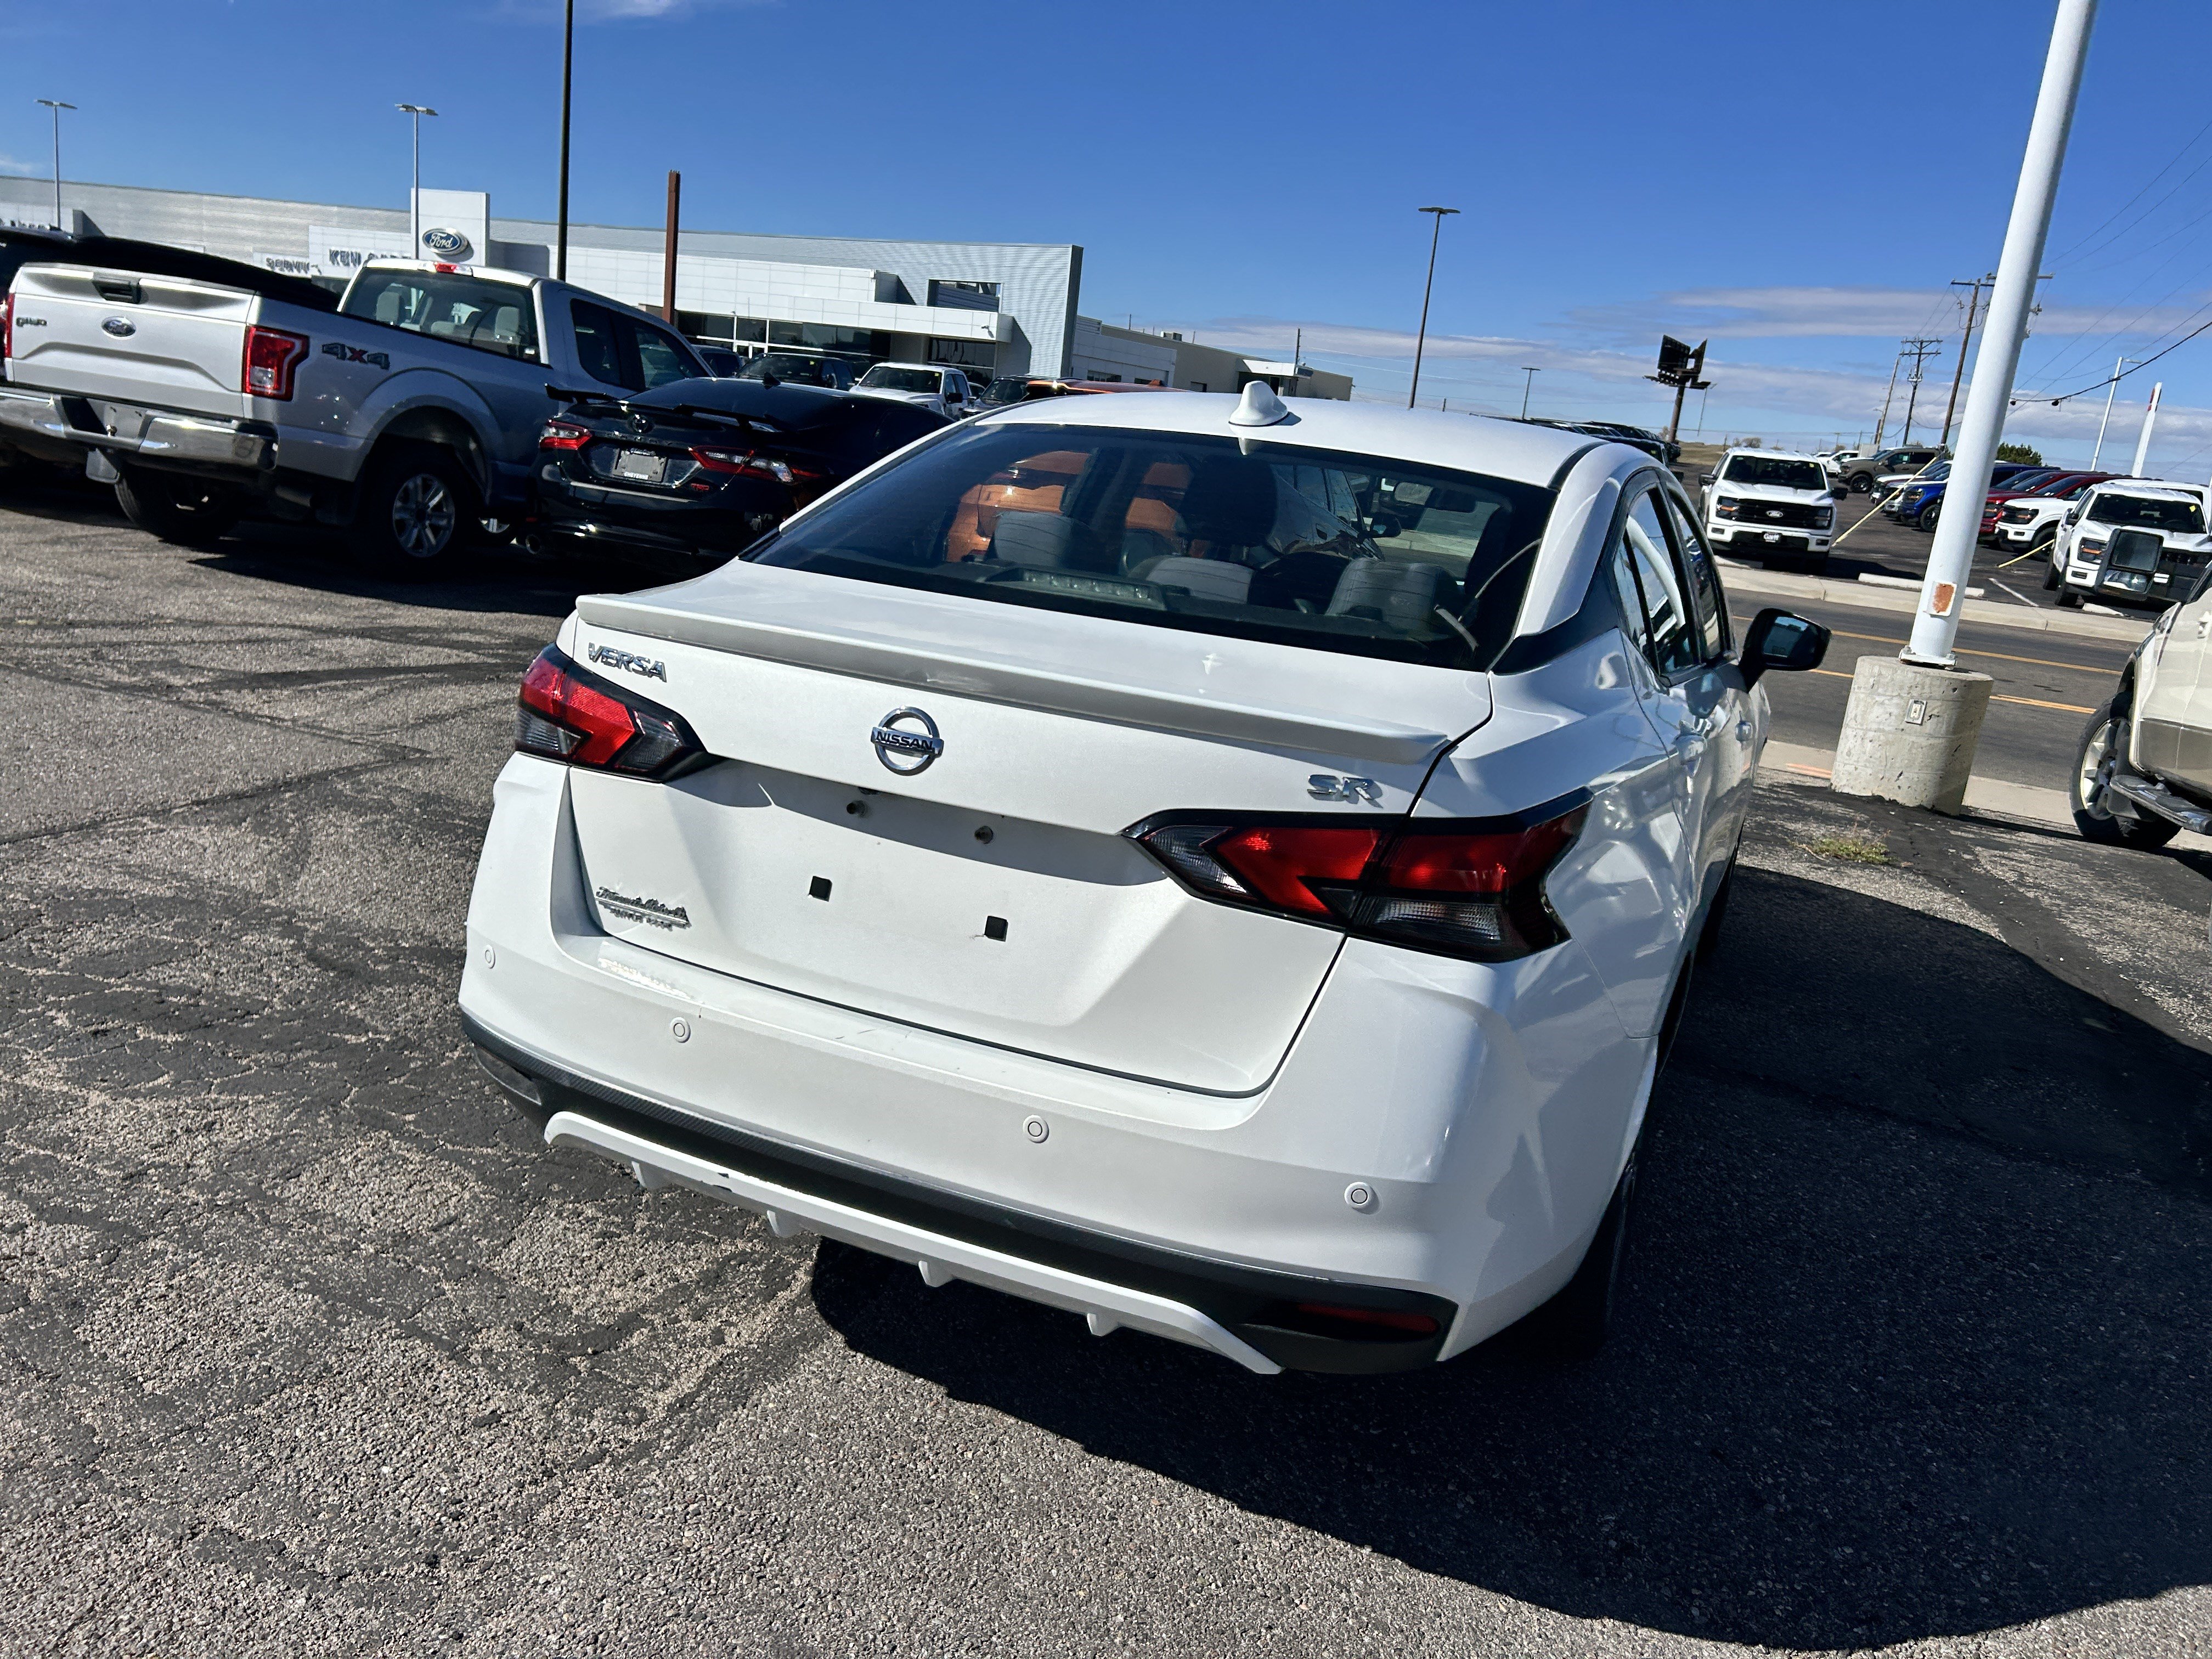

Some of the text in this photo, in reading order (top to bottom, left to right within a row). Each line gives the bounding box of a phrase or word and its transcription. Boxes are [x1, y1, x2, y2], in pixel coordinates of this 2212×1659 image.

[429, 232, 453, 248] Ford
[588, 642, 667, 682] VERSA
[876, 731, 934, 751] NISSAN
[1307, 774, 1375, 800] SR
